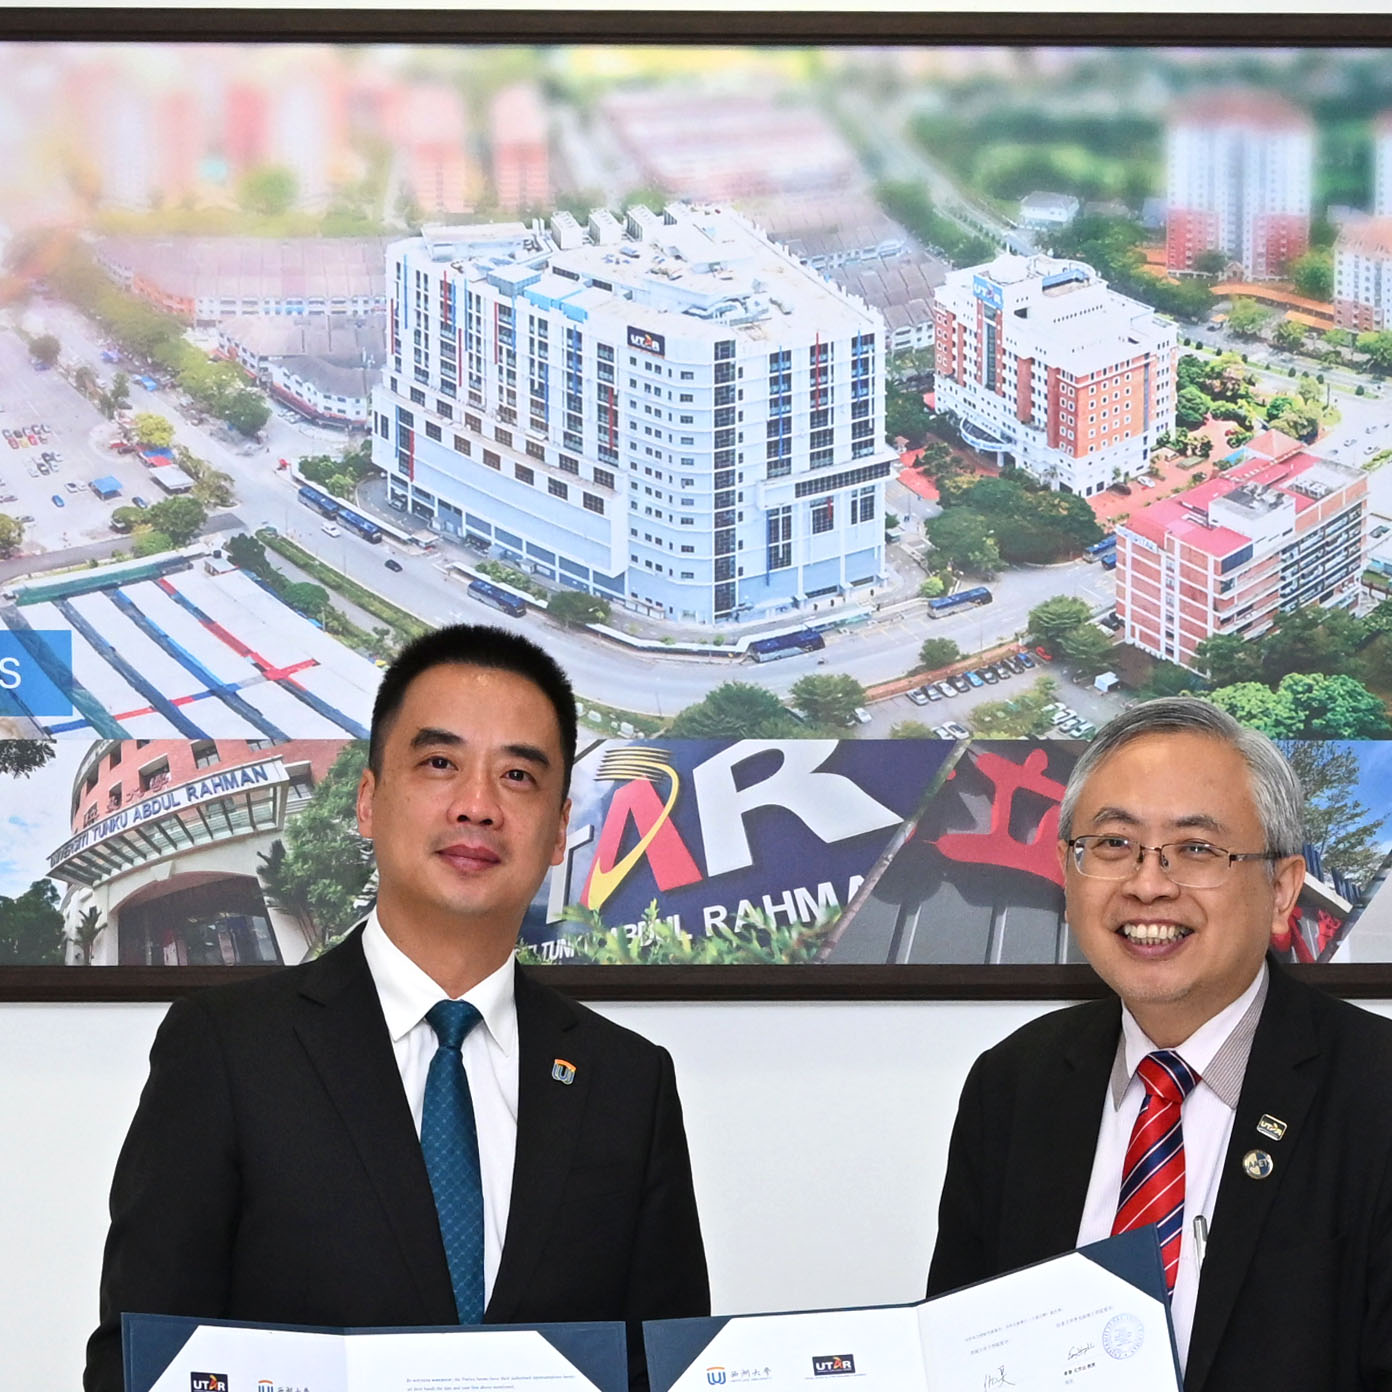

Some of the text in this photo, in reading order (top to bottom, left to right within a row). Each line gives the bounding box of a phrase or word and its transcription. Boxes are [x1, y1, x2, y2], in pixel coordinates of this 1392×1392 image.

[93, 812, 128, 842] TUNKU
[133, 793, 181, 821] ABDUL
[187, 765, 268, 802] RAHMAN
[816, 1361, 852, 1371] UTAR
[193, 1379, 226, 1392] UTAR
